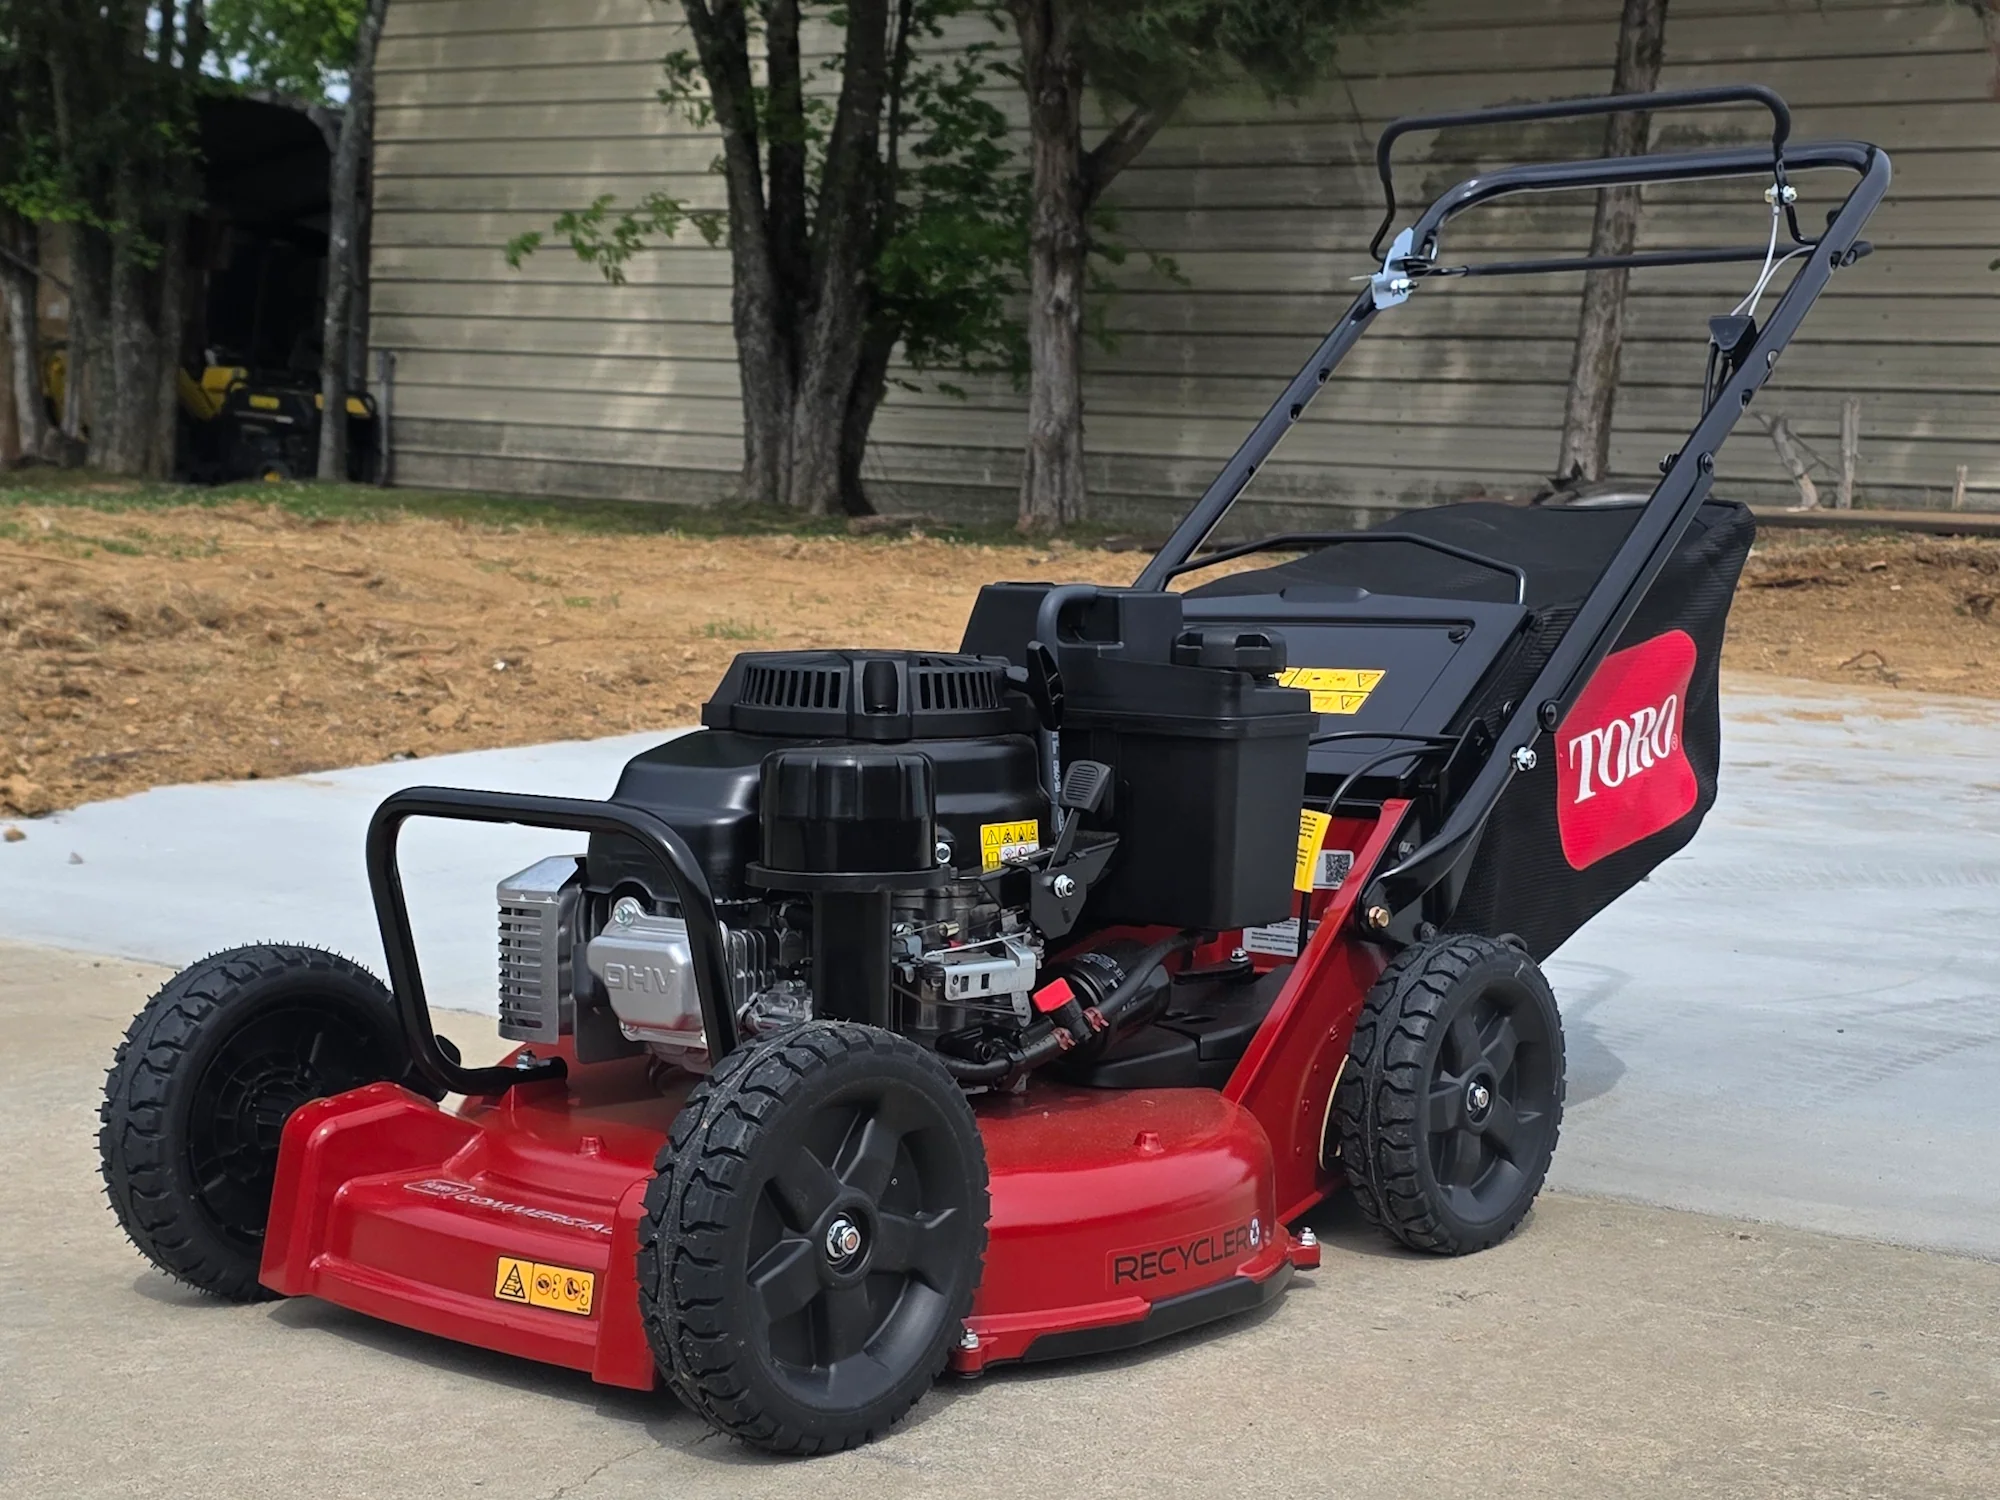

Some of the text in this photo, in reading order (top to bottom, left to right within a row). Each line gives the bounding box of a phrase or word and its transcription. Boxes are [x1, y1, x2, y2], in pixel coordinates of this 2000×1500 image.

[1568, 694, 1678, 804] TORO
[604, 962, 677, 994] OHV
[1114, 1225, 1248, 1285] RECYCLER
